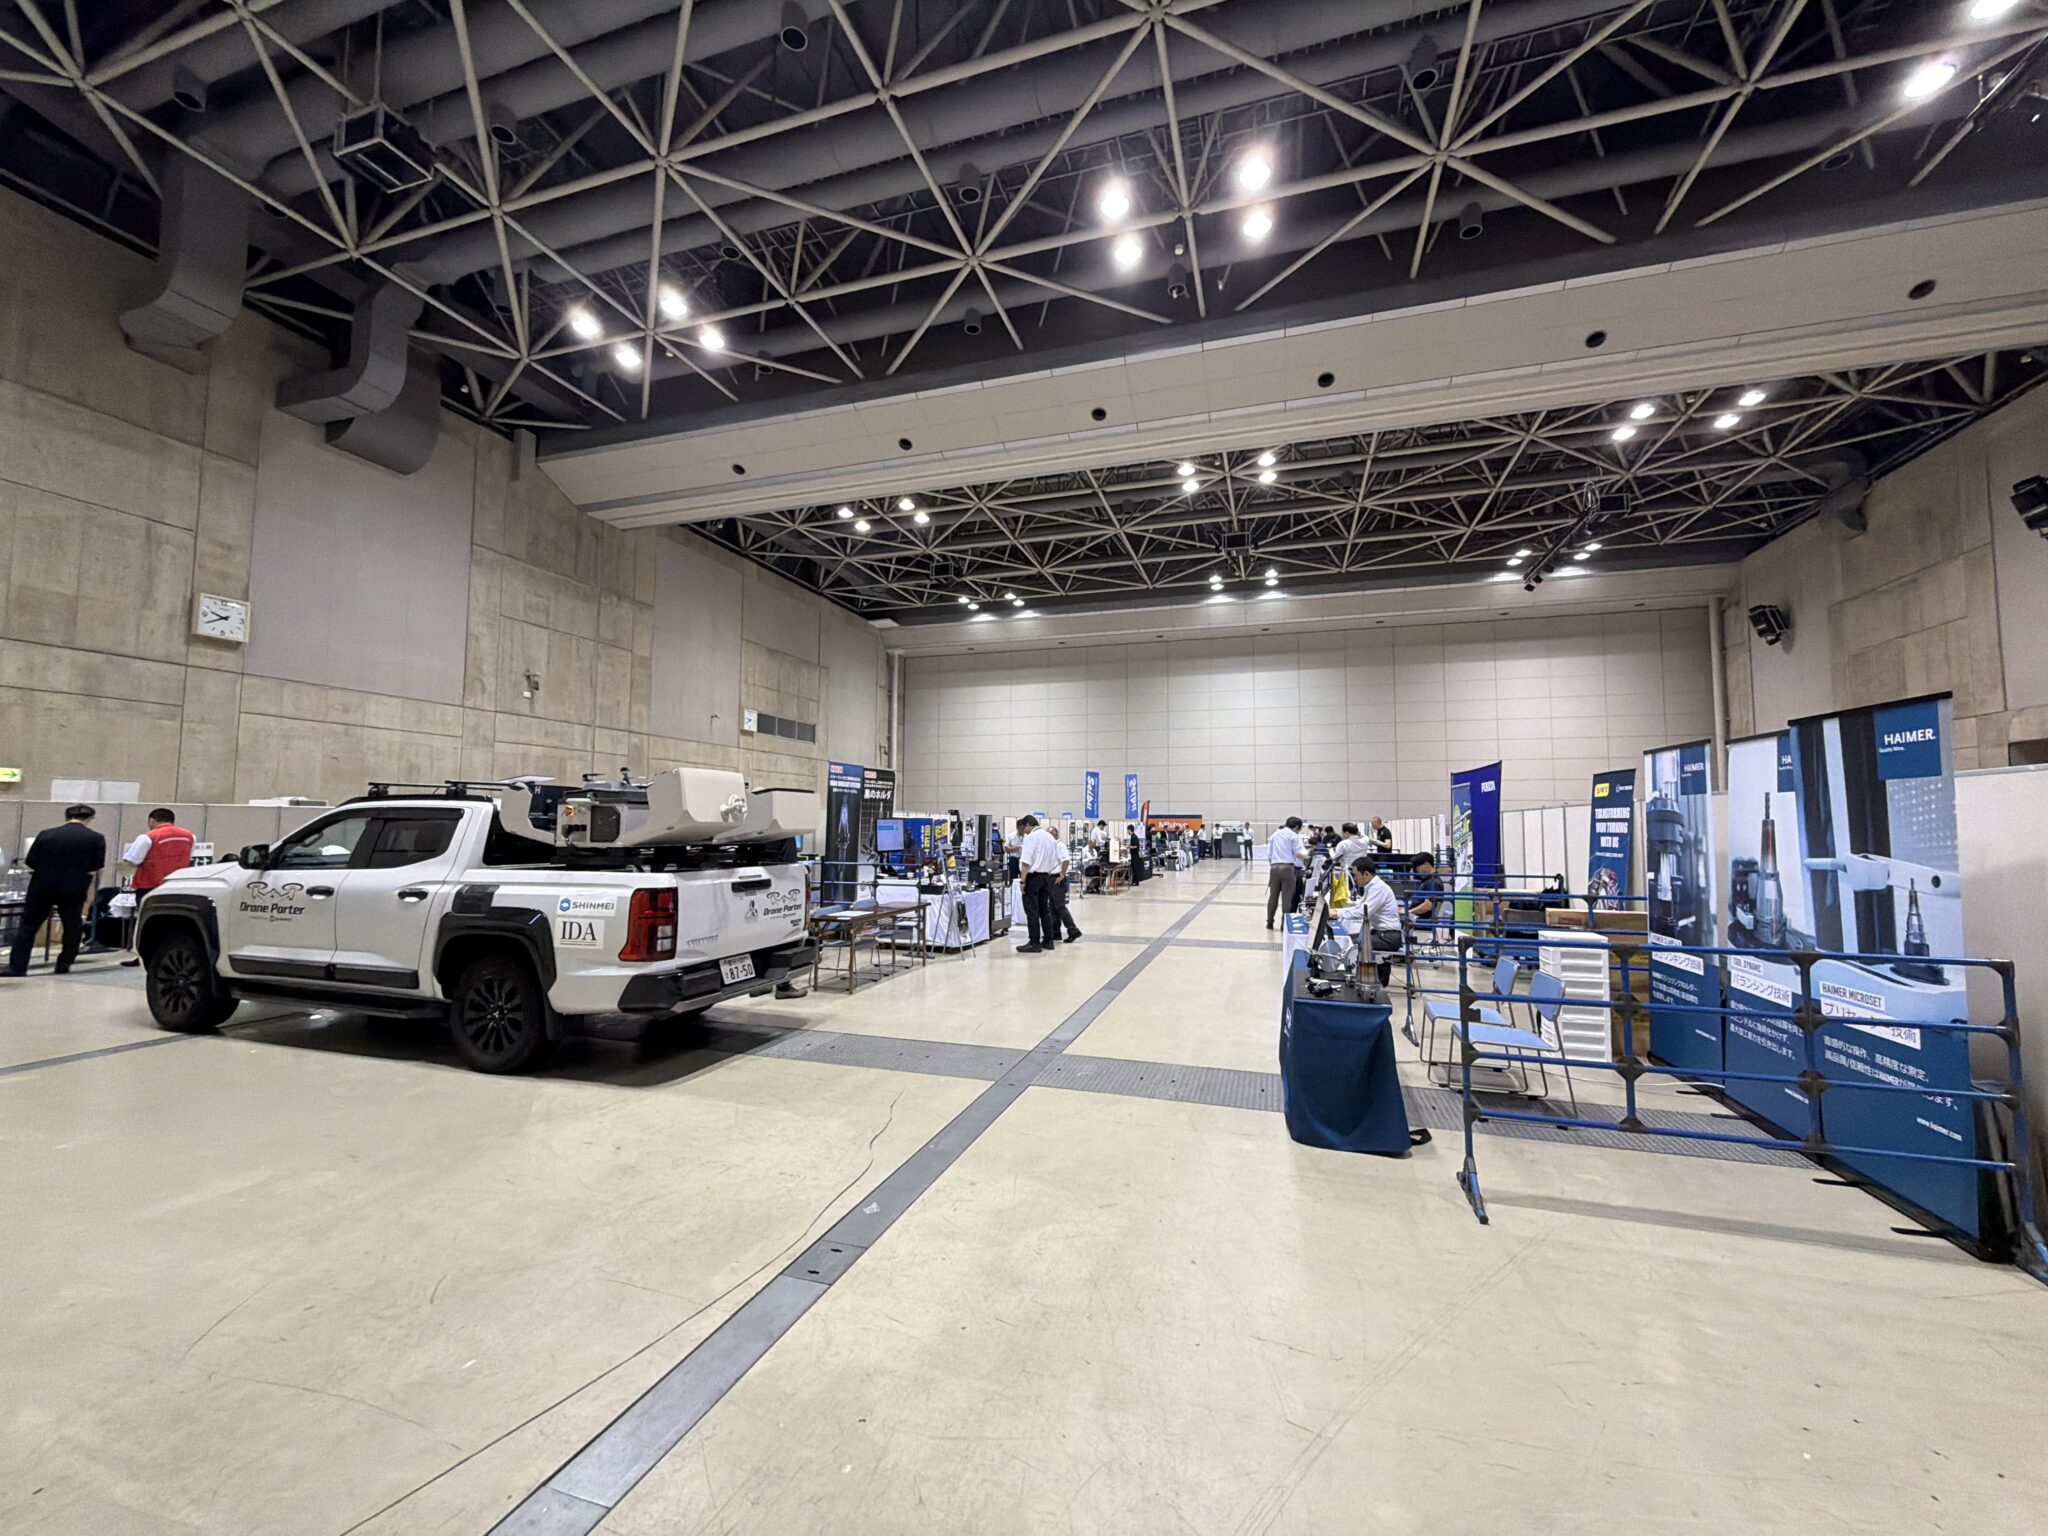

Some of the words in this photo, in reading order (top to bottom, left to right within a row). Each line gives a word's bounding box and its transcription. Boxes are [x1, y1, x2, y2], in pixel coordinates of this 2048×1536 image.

[240, 901, 269, 913] Drone
[270, 903, 305, 915] Porter
[572, 902, 615, 910] SHINMEI
[560, 921, 597, 941] IDA
[729, 963, 753, 980] 87-50
[1822, 983, 1847, 998] HAIMER
[1849, 989, 1882, 1007] MICROSET
